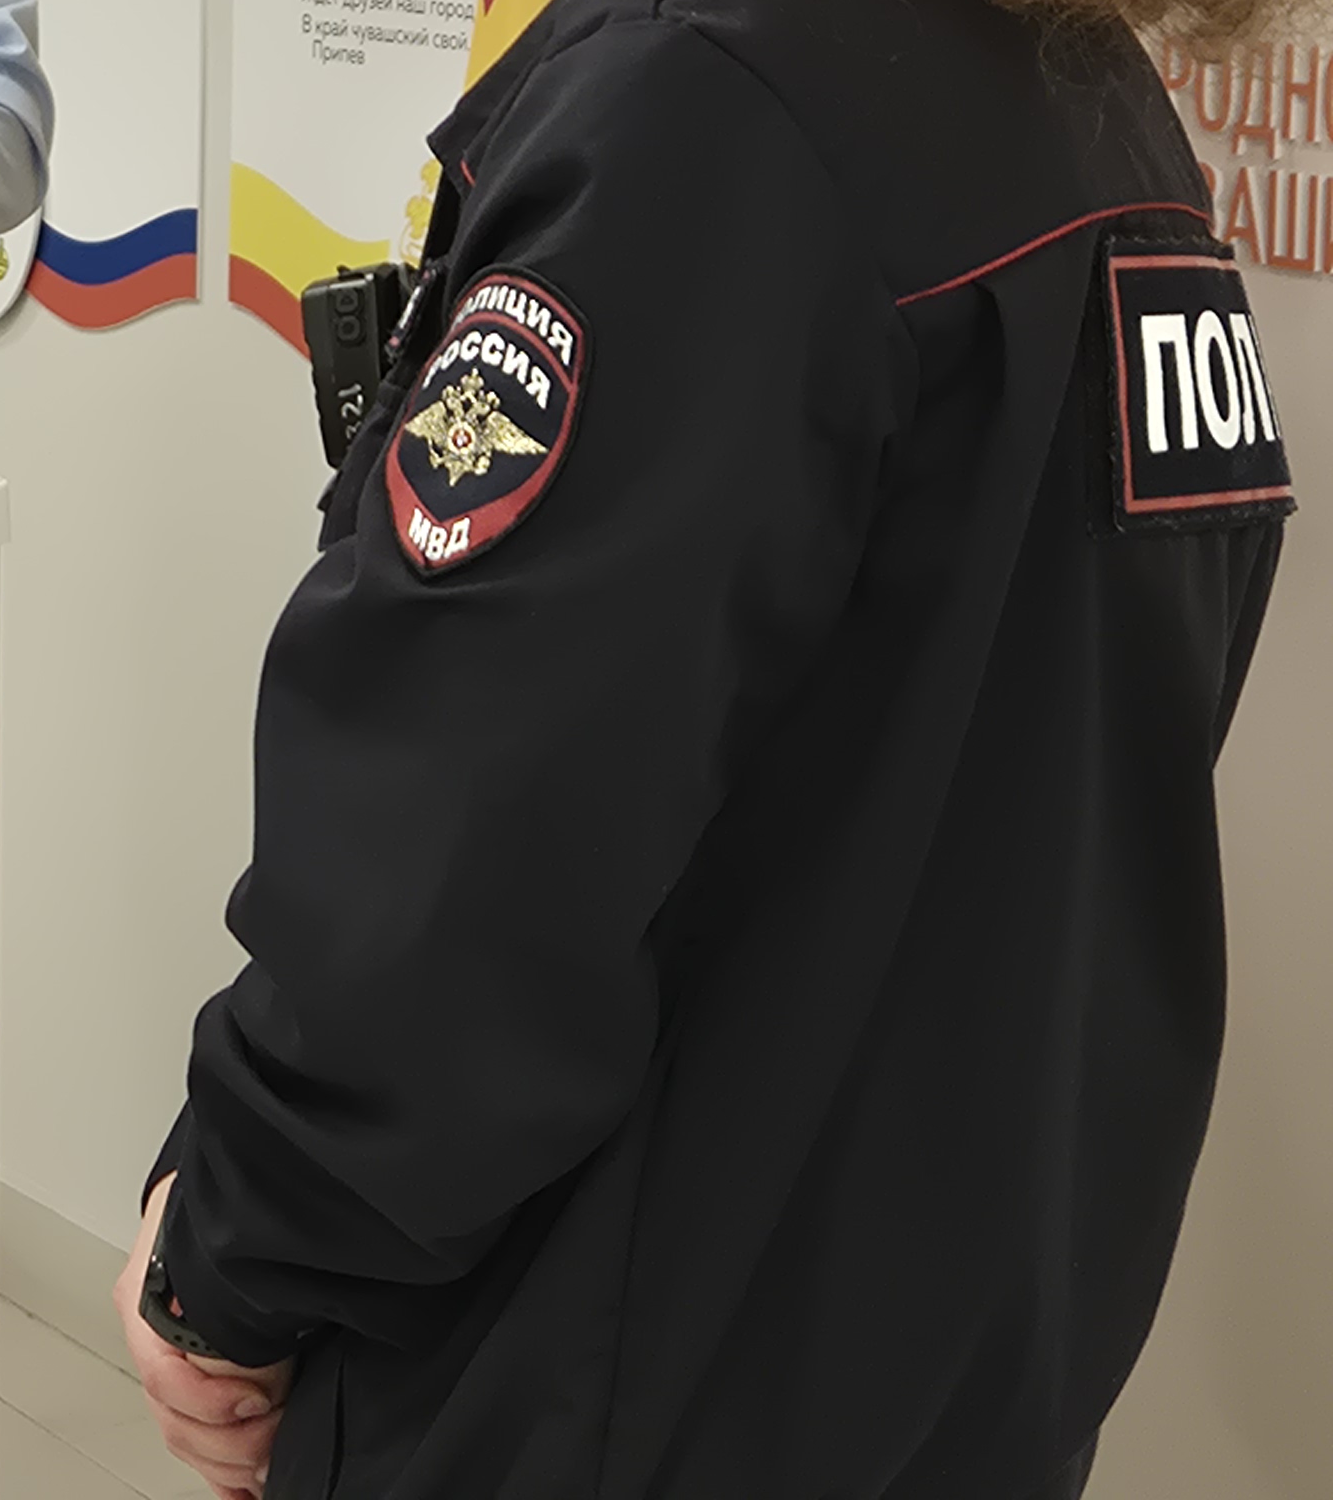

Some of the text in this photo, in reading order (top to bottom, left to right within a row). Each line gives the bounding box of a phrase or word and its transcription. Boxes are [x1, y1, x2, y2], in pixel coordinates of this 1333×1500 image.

[430, 1, 475, 21] город
[302, 13, 311, 33] В
[316, 19, 348, 39] край
[352, 26, 428, 45] чувашский
[313, 40, 365, 65] Припев
[1141, 310, 1280, 453] ПОЛ
[408, 507, 471, 561] МВД
